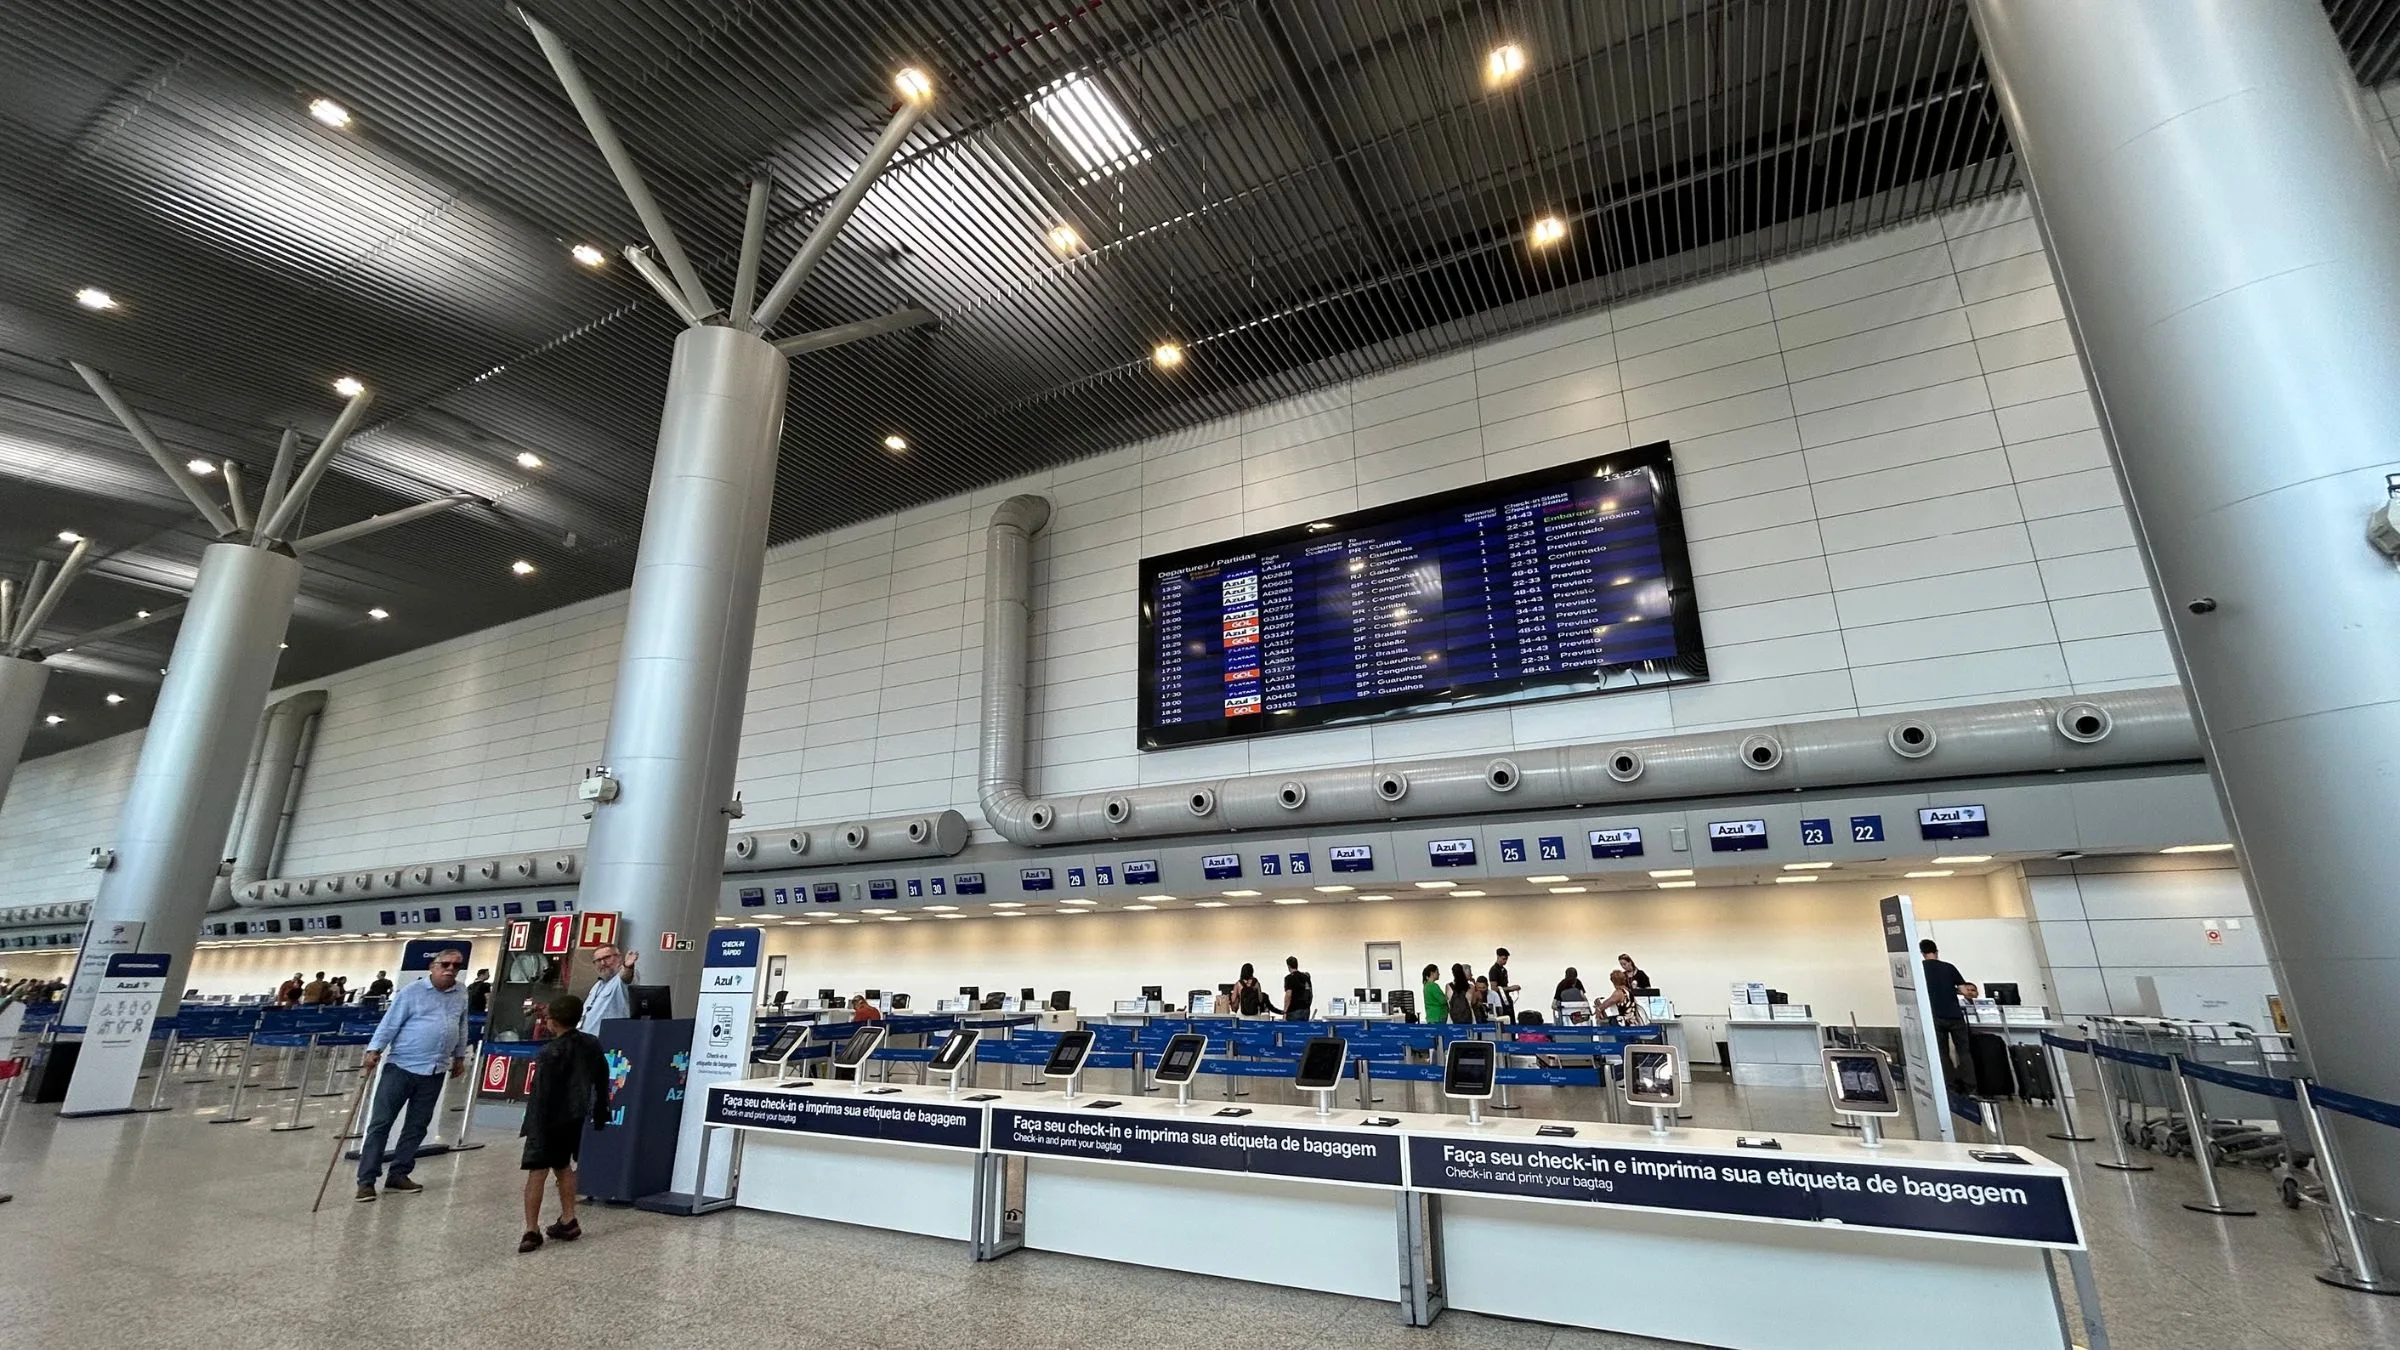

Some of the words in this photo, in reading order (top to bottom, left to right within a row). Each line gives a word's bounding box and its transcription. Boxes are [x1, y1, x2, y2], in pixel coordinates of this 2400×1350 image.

[1603, 469, 1640, 481] 13:22
[1541, 492, 1568, 502] Status
[1369, 540, 1401, 550] Curitiba
[1506, 511, 1532, 521] 34-43
[1224, 580, 1245, 588] Azul
[1370, 547, 1412, 558] Guarulhos
[1506, 521, 1533, 531] 22-33
[1544, 508, 1595, 523] Embarque
[1224, 588, 1246, 596] Azul
[1370, 554, 1418, 568] Congonhas
[1507, 530, 1534, 540] 22-33
[1545, 518, 1596, 533] Embarque
[1599, 510, 1640, 523] próximo
[1158, 562, 1208, 578] Departures
[1217, 553, 1256, 566] Partidas
[1225, 596, 1246, 604] Azul
[1370, 566, 1400, 576] Galeão
[1509, 540, 1536, 549] 22-33
[1546, 526, 1604, 542] Confirmado
[1371, 572, 1419, 585] Congonhas
[1510, 549, 1537, 558] 34-43
[1547, 539, 1587, 550] Previsto
[1224, 613, 1246, 621] Azul
[1511, 558, 1538, 567] 22-33
[1548, 545, 1606, 560] Confirmado
[1372, 590, 1421, 603] Congonhas
[1550, 558, 1590, 570] Previsto
[1552, 577, 1593, 589] Previsto
[1225, 629, 1247, 638] Azul
[1373, 602, 1406, 612] Curitiba
[1513, 577, 1540, 586] 22-33
[1551, 567, 1592, 579] Previsto
[1374, 617, 1423, 630] Congonhas
[1515, 596, 1543, 605] 34-43
[1553, 587, 1594, 599] Previsto
[1375, 629, 1406, 639] Brasília
[1516, 606, 1544, 615] 34-43
[1555, 597, 1596, 609] Previsto
[1374, 638, 1405, 648] Galeão
[1517, 615, 1545, 624] 34-43
[1556, 607, 1597, 618] Previsto
[1376, 648, 1408, 657] Brasília
[1557, 617, 1598, 628] Previsto
[1376, 655, 1421, 666] Guarulhos
[1519, 636, 1547, 644] 34-43
[1558, 627, 1599, 638] Previsto
[1377, 664, 1427, 676] Congonhas
[1520, 645, 1548, 654] 34-43
[1559, 637, 1600, 648] Previsto
[1378, 674, 1422, 685] Guarulhos
[1521, 655, 1549, 664] 22-33
[1560, 647, 1602, 658] Previsto
[1378, 684, 1424, 694] Guarulhos
[1562, 658, 1603, 668] Previsto
[1930, 811, 1960, 821] Azul
[1597, 832, 1621, 842] Azul
[1718, 823, 1744, 835] Azul
[1805, 829, 1823, 844] 23
[1855, 826, 1874, 840] 22
[1336, 849, 1355, 858] Azul
[1436, 842, 1456, 851] Azul
[1504, 848, 1518, 860] 25
[1542, 846, 1558, 858] 24
[1127, 863, 1144, 872] Azul
[1208, 858, 1226, 867] Azul
[1263, 862, 1275, 874] 27
[1292, 861, 1305, 873] 26
[1025, 870, 1040, 878] Azul
[1070, 875, 1080, 886] 29
[1098, 873, 1109, 884] 28
[910, 886, 917, 895] 31
[933, 885, 941, 894] 30
[513, 926, 527, 947] H
[584, 917, 610, 943] H
[714, 976, 732, 986] Azul
[665, 1088, 683, 1101] Az
[722, 1108, 743, 1116] Check-in
[754, 1112, 765, 1120] print
[778, 1114, 796, 1124] bagtag
[723, 1094, 743, 1108] Faça
[744, 1098, 759, 1108] seu
[761, 1098, 796, 1111] check-in
[798, 1103, 804, 1111] e
[806, 1101, 842, 1115] imprima
[844, 1106, 861, 1116] sua
[863, 1106, 901, 1120] etiqueta
[903, 1109, 916, 1121] de
[918, 1110, 966, 1127] bagagem
[1014, 1115, 1041, 1134] Faça
[1044, 1121, 1065, 1132] seu
[1068, 1120, 1120, 1137] check-in
[1124, 1128, 1132, 1138] e
[1136, 1126, 1188, 1143] imprima
[1192, 1133, 1216, 1145] sua
[1220, 1133, 1277, 1150] etiqueta
[1281, 1136, 1299, 1151] de
[1304, 1138, 1376, 1158] bagagem
[1014, 1132, 1044, 1143] Check-in
[1046, 1137, 1059, 1145] and
[1061, 1139, 1076, 1147] print
[1078, 1141, 1094, 1149] your
[1096, 1140, 1121, 1153] bagtag
[1444, 1145, 1486, 1168] Faça
[1491, 1152, 1523, 1166] seu
[1528, 1151, 1609, 1174] check-in
[1615, 1161, 1626, 1173] e
[1632, 1160, 1716, 1180] imprima
[1722, 1168, 1761, 1183] sua
[1767, 1168, 1860, 1191] etiqueta
[1867, 1174, 1897, 1193] de
[1902, 1176, 2027, 1205] bagagem
[1446, 1166, 1492, 1179] Check-in
[1495, 1171, 1515, 1181] and
[1518, 1172, 1543, 1184] print
[1545, 1176, 1570, 1186] your
[1573, 1176, 1613, 1191] bagtag
